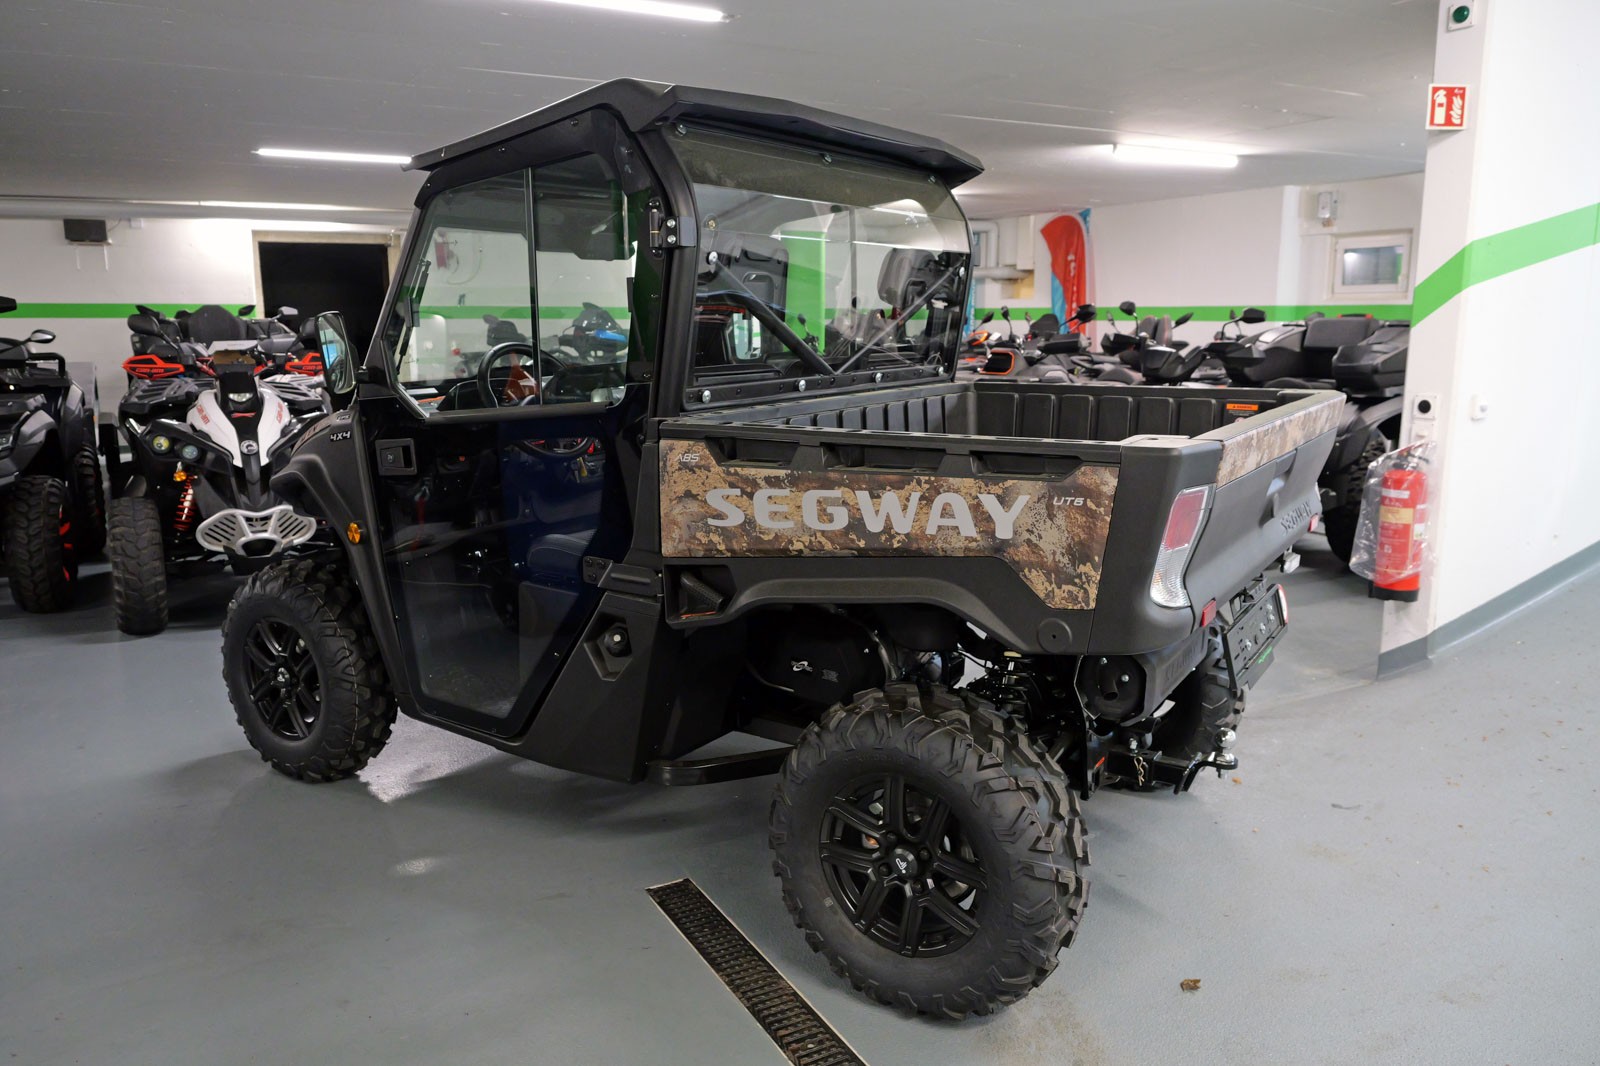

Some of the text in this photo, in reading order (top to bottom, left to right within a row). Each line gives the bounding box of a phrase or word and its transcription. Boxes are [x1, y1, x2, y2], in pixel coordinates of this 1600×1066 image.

[329, 430, 352, 442] 4X4
[1052, 496, 1085, 506] UT6
[705, 487, 1031, 540] SEGWAY
